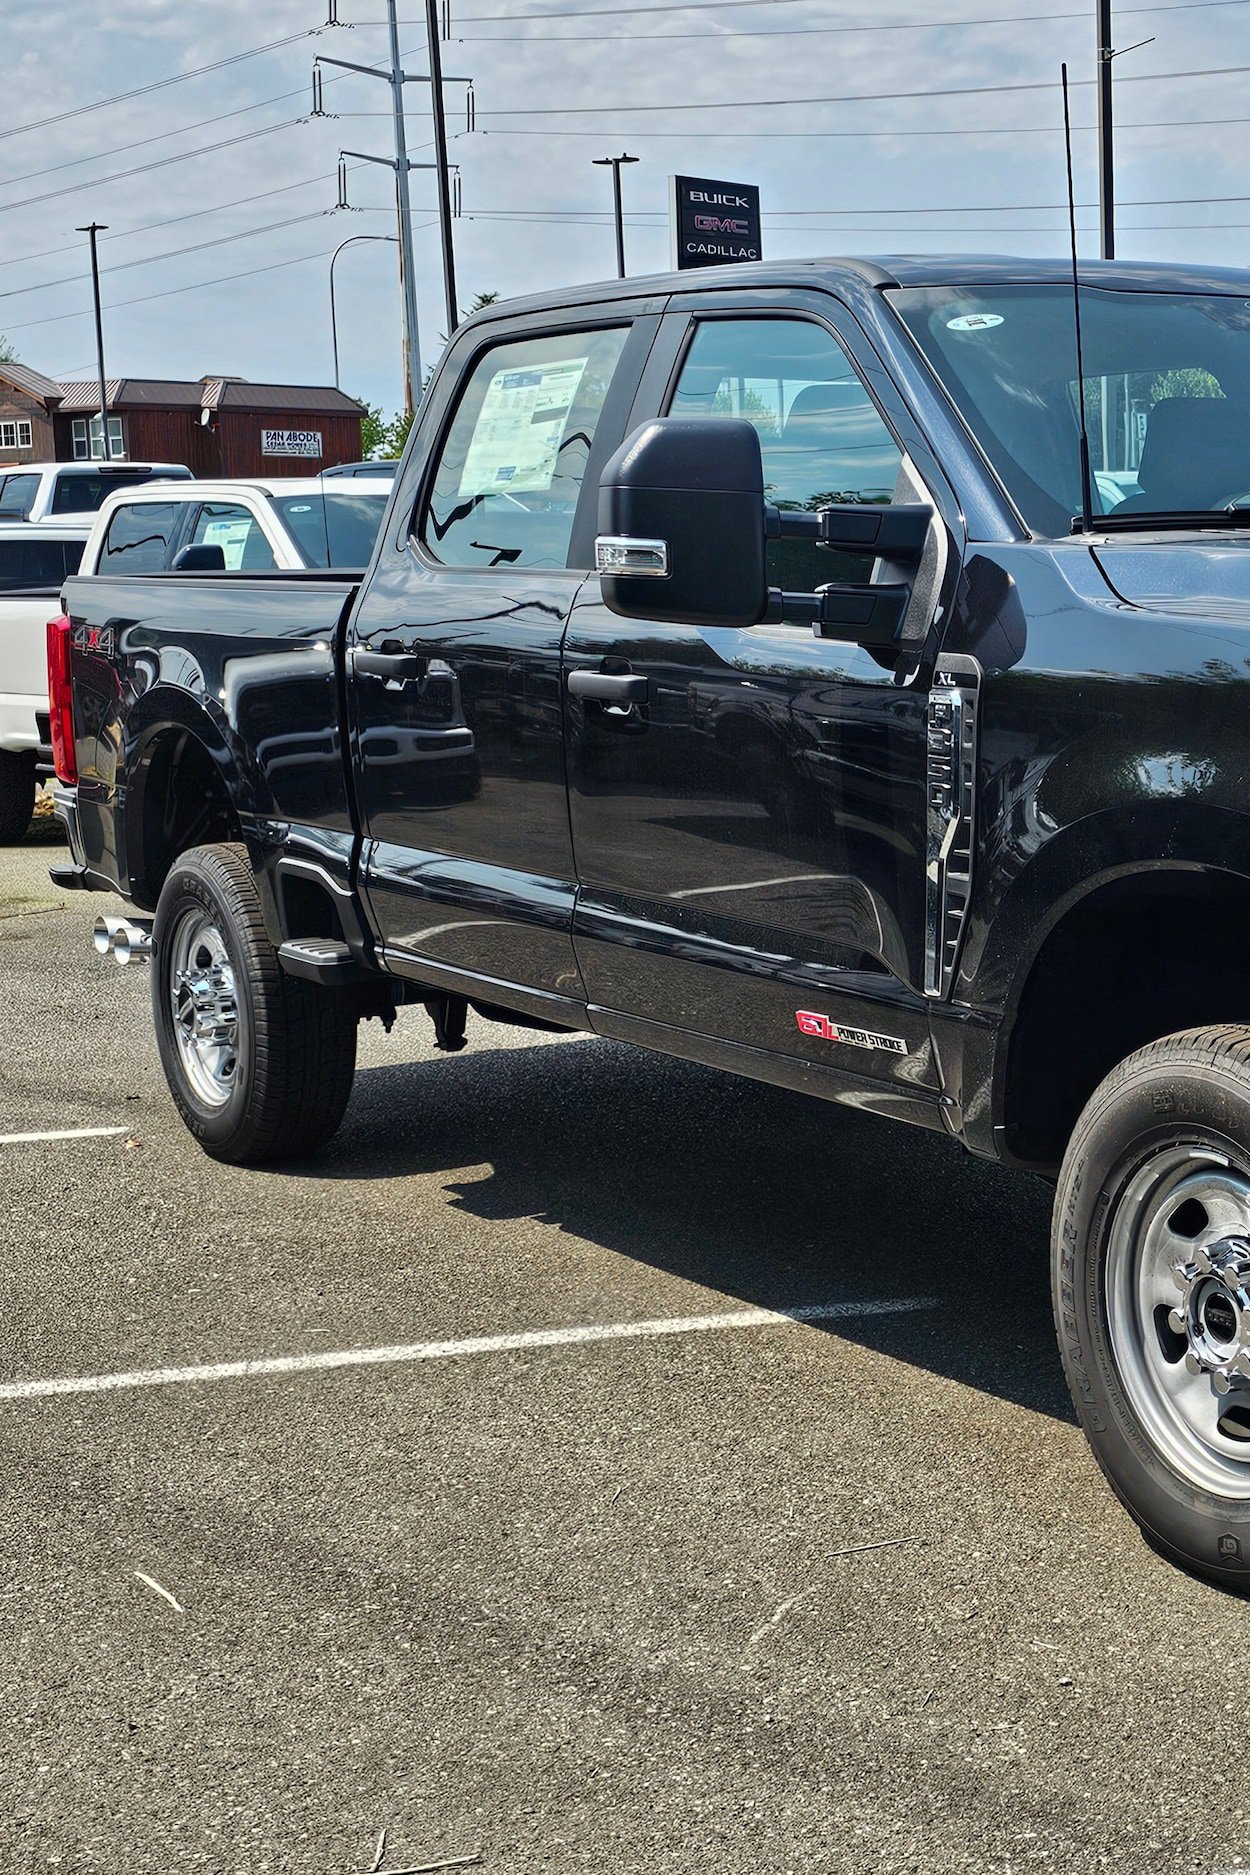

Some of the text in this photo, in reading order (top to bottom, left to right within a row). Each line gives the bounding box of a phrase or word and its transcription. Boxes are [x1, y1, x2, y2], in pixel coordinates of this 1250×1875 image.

[689, 190, 750, 208] BUICK
[694, 215, 749, 235] GMC
[686, 242, 757, 259] CADILLAC
[266, 431, 318, 443] PAN ABODE
[938, 671, 956, 686] XL
[837, 1026, 869, 1044] POWER
[868, 1034, 905, 1052] STROKE
[1061, 1216, 1108, 1435] GRABBER
